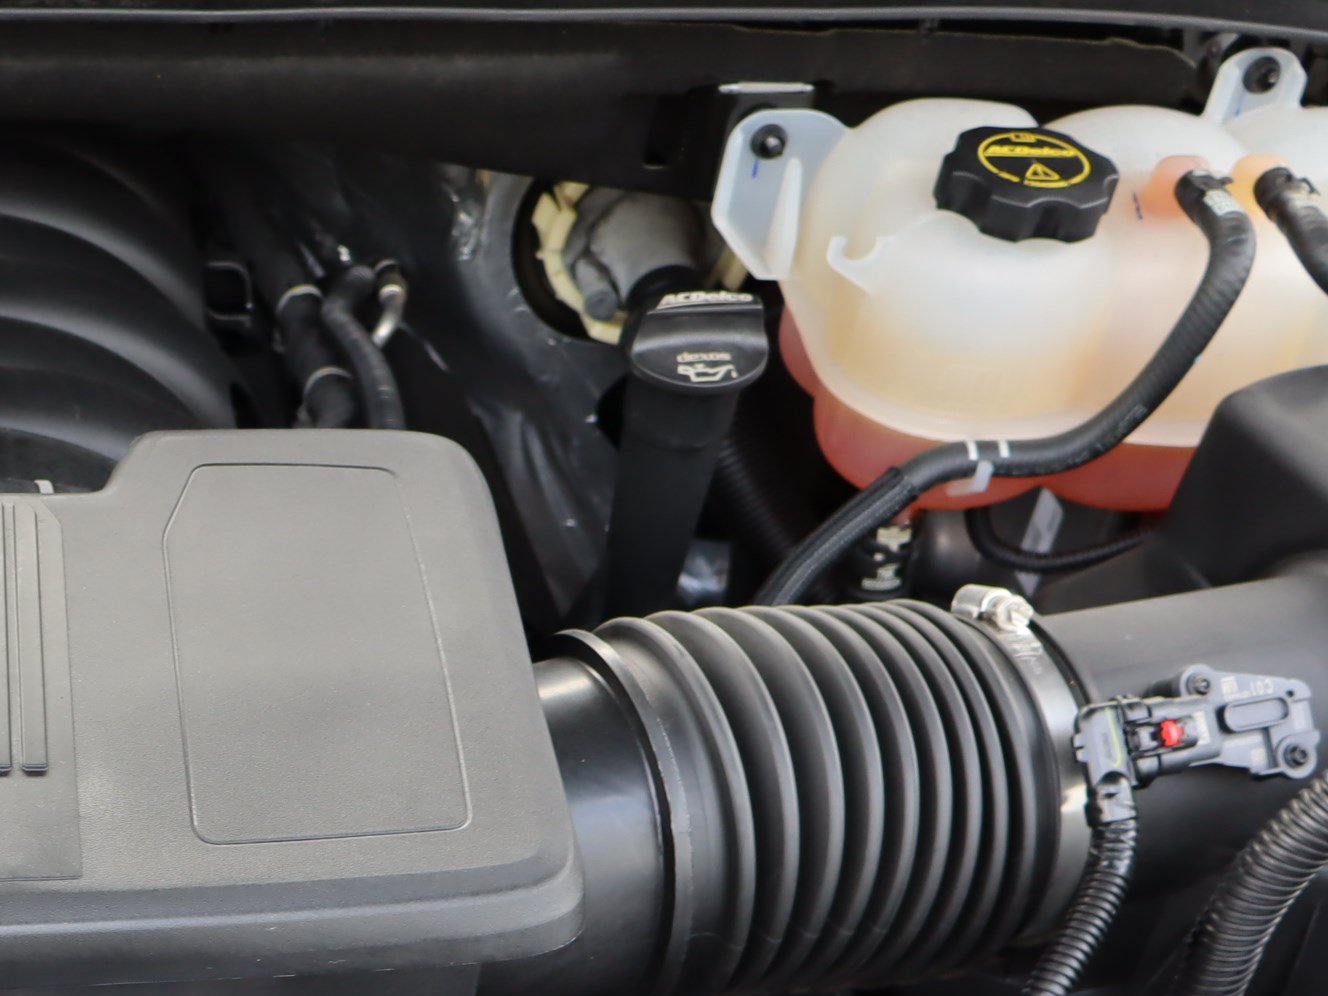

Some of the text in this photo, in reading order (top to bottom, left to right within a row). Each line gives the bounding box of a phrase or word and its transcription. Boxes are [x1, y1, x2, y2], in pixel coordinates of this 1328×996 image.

[983, 144, 1077, 158] ACDelco
[656, 290, 754, 310] ACDelco
[676, 352, 732, 363] dexos
